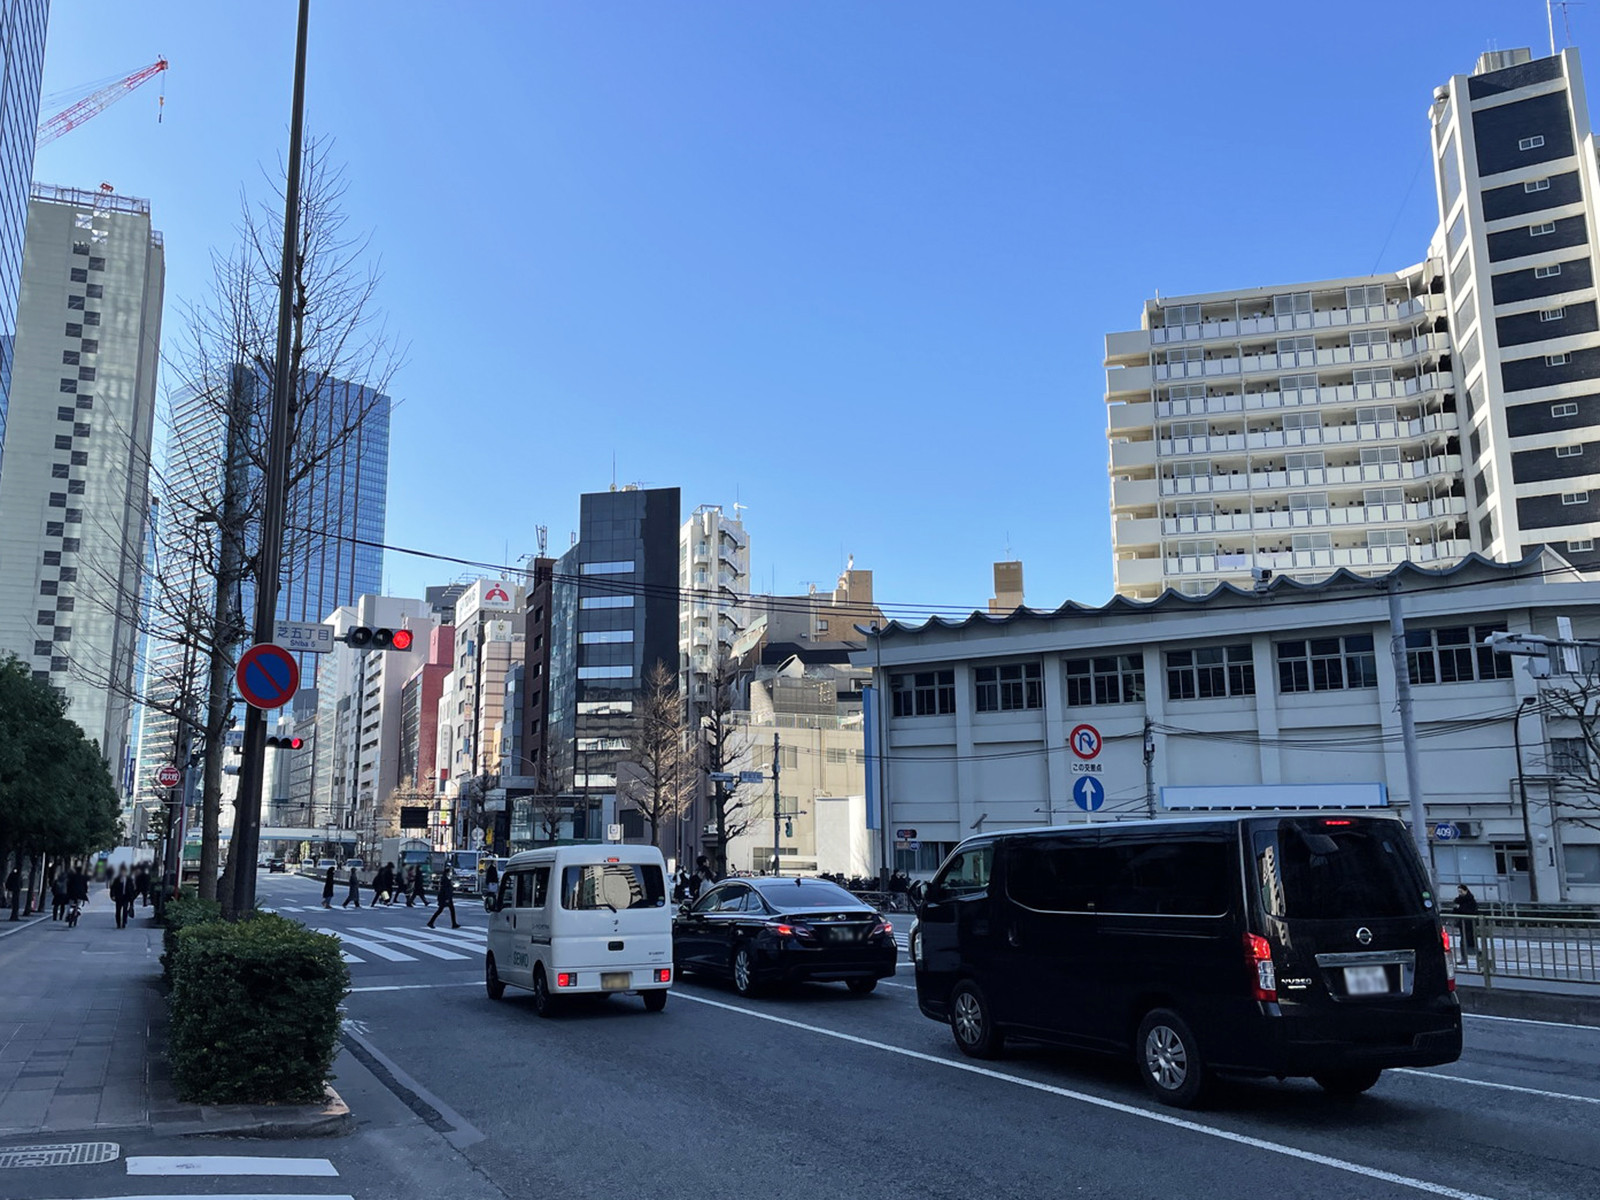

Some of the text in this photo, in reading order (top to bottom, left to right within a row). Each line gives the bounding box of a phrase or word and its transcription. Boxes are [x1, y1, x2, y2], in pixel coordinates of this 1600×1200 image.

[276, 626, 329, 640] 芝五丁目
[1072, 763, 1102, 772] この交差点
[1436, 827, 1451, 837] 409
